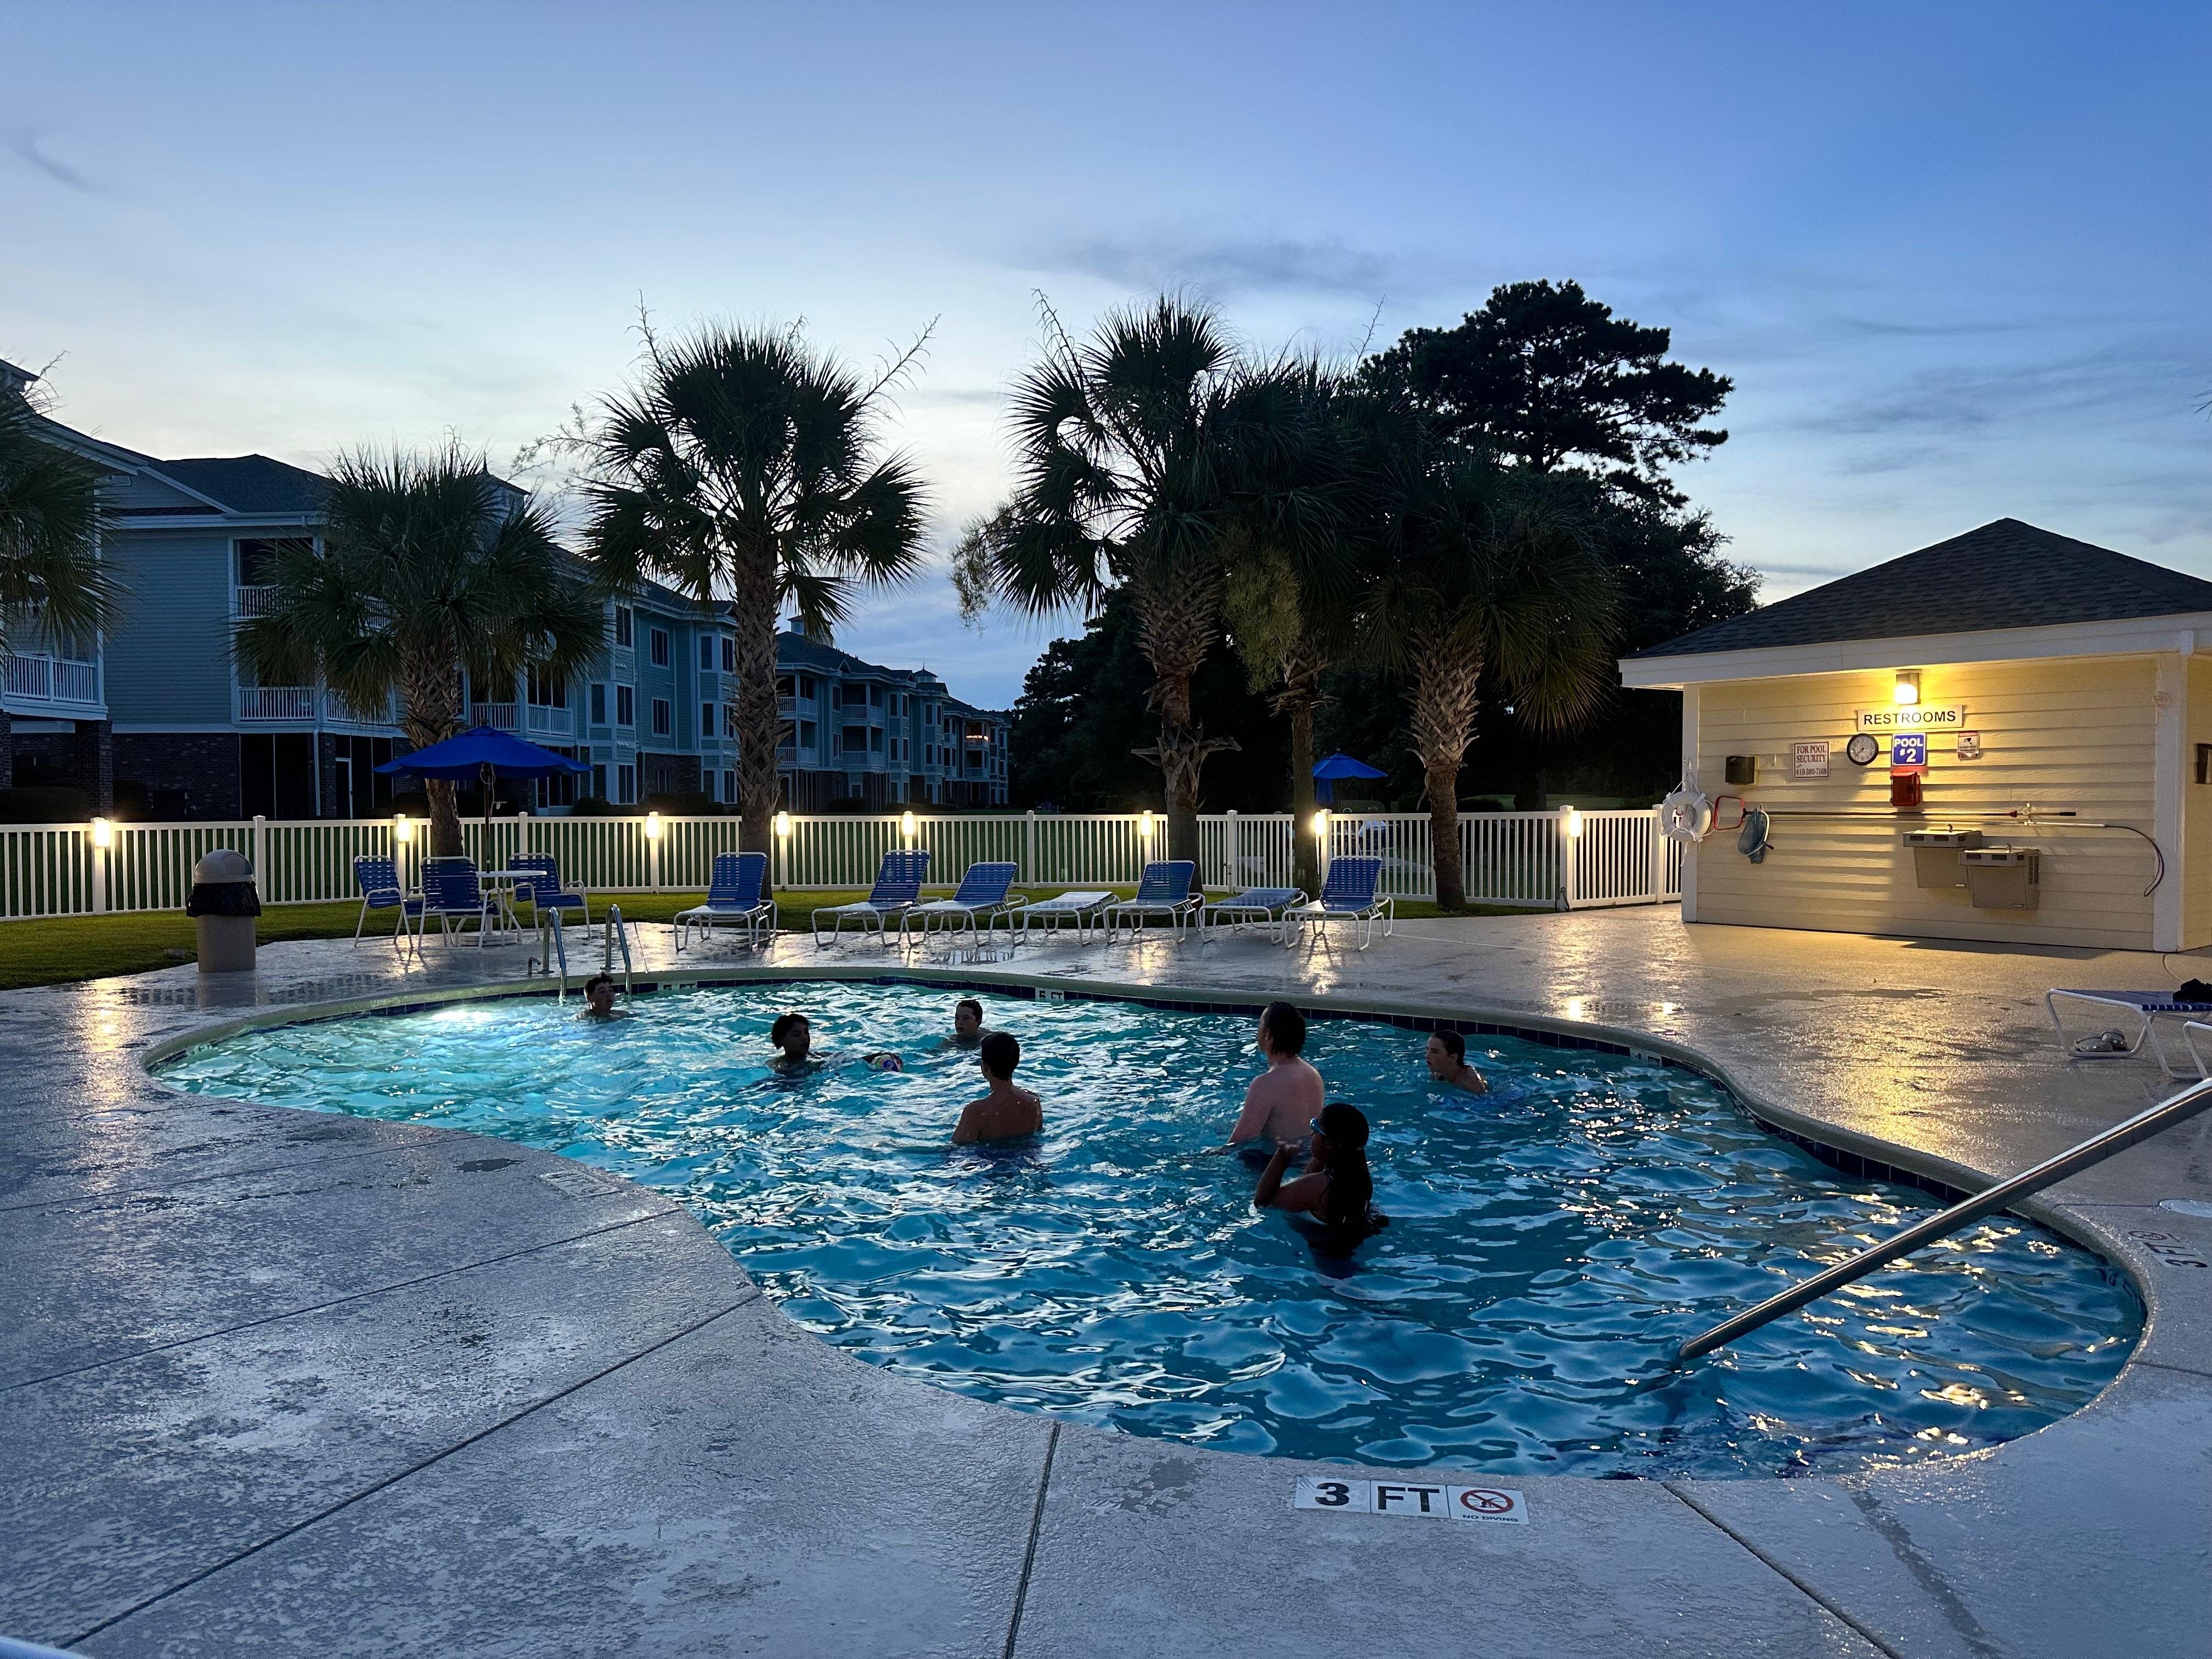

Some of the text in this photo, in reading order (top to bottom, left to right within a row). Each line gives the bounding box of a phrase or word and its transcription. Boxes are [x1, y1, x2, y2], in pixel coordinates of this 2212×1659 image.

[1864, 710, 1956, 725] RESTROOMS
[1894, 738, 1923, 747] POOL
[1797, 745, 1826, 754] FOR POOL
[1796, 754, 1826, 763] SECURITY
[1314, 1482, 1440, 1513] 3 FT
